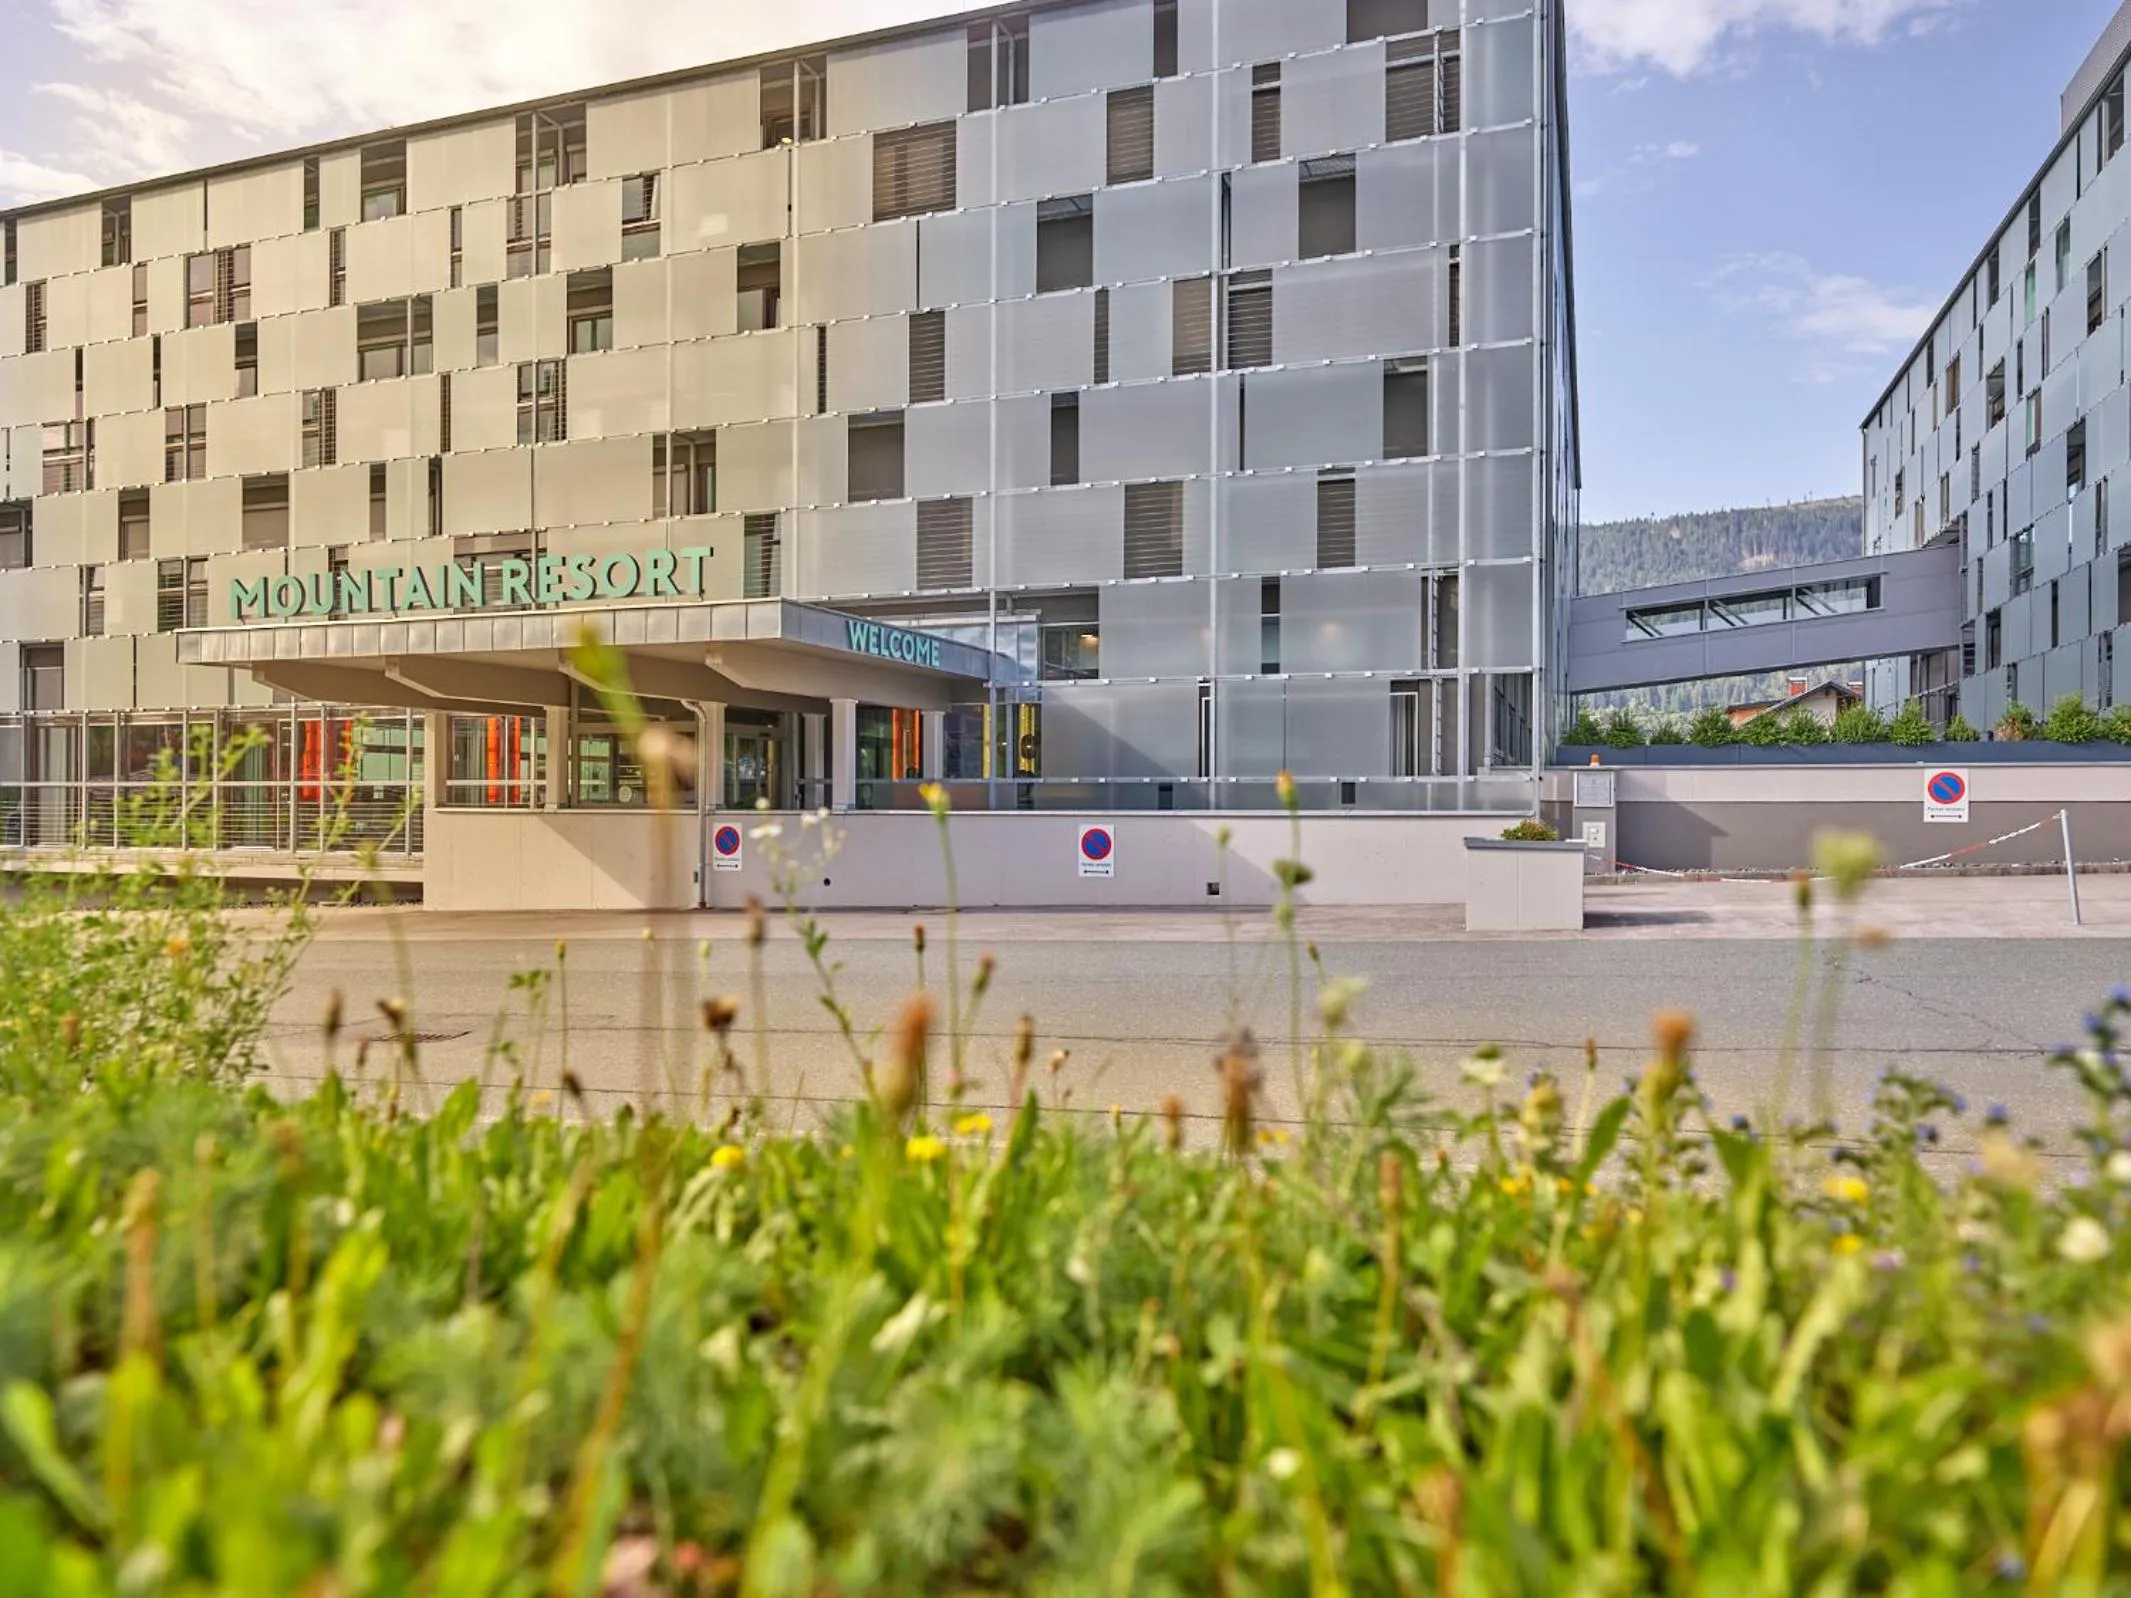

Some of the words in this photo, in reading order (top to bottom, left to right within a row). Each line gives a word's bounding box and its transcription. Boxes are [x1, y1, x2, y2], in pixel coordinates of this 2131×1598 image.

[230, 561, 488, 620] MOUNTAIN
[502, 546, 714, 604] RESORT
[848, 619, 941, 668] WELCOME
